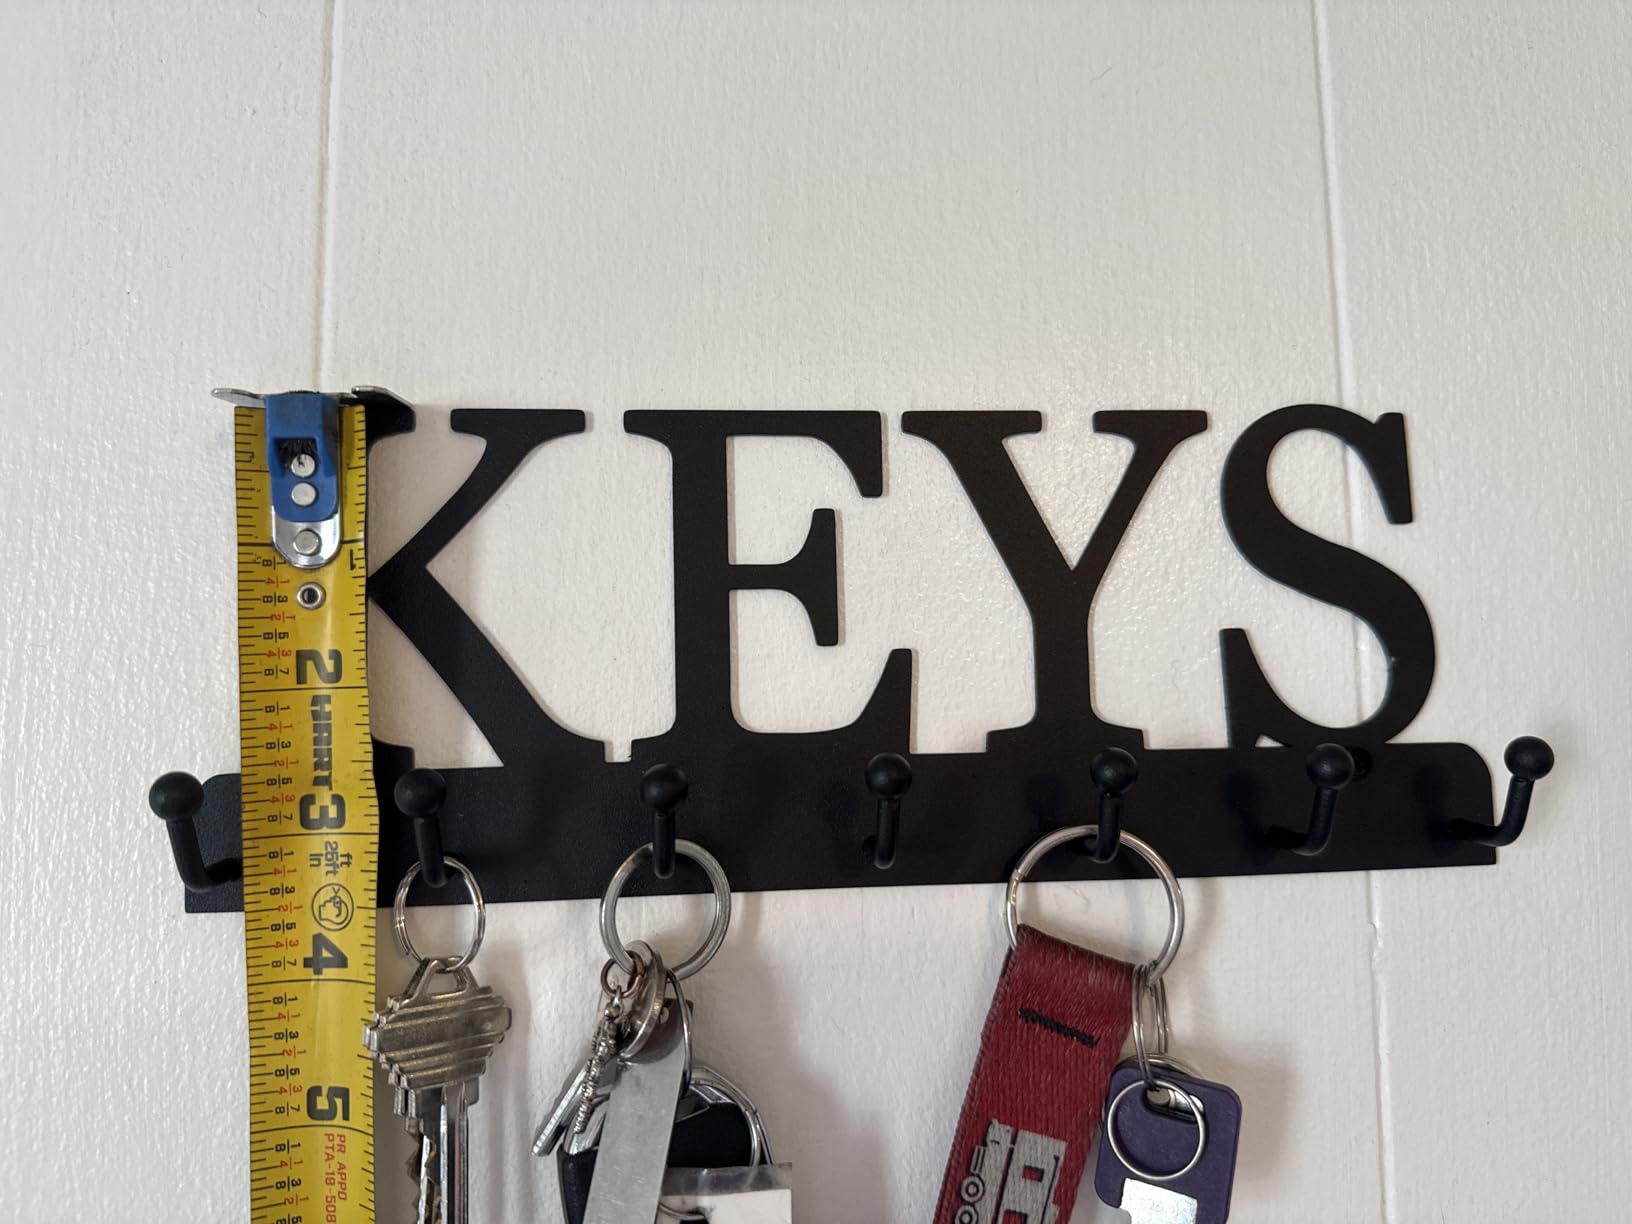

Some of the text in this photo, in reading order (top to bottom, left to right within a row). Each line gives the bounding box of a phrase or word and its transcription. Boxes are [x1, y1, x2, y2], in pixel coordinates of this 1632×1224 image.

[368, 404, 1436, 768] KEYS
[296, 649, 343, 685] 2
[299, 793, 346, 830] 3
[324, 840, 339, 876] 25ft
[340, 851, 353, 868] ft
[303, 932, 349, 976] 4
[306, 1085, 350, 1121] 5
[336, 1133, 348, 1201] PR APPD
